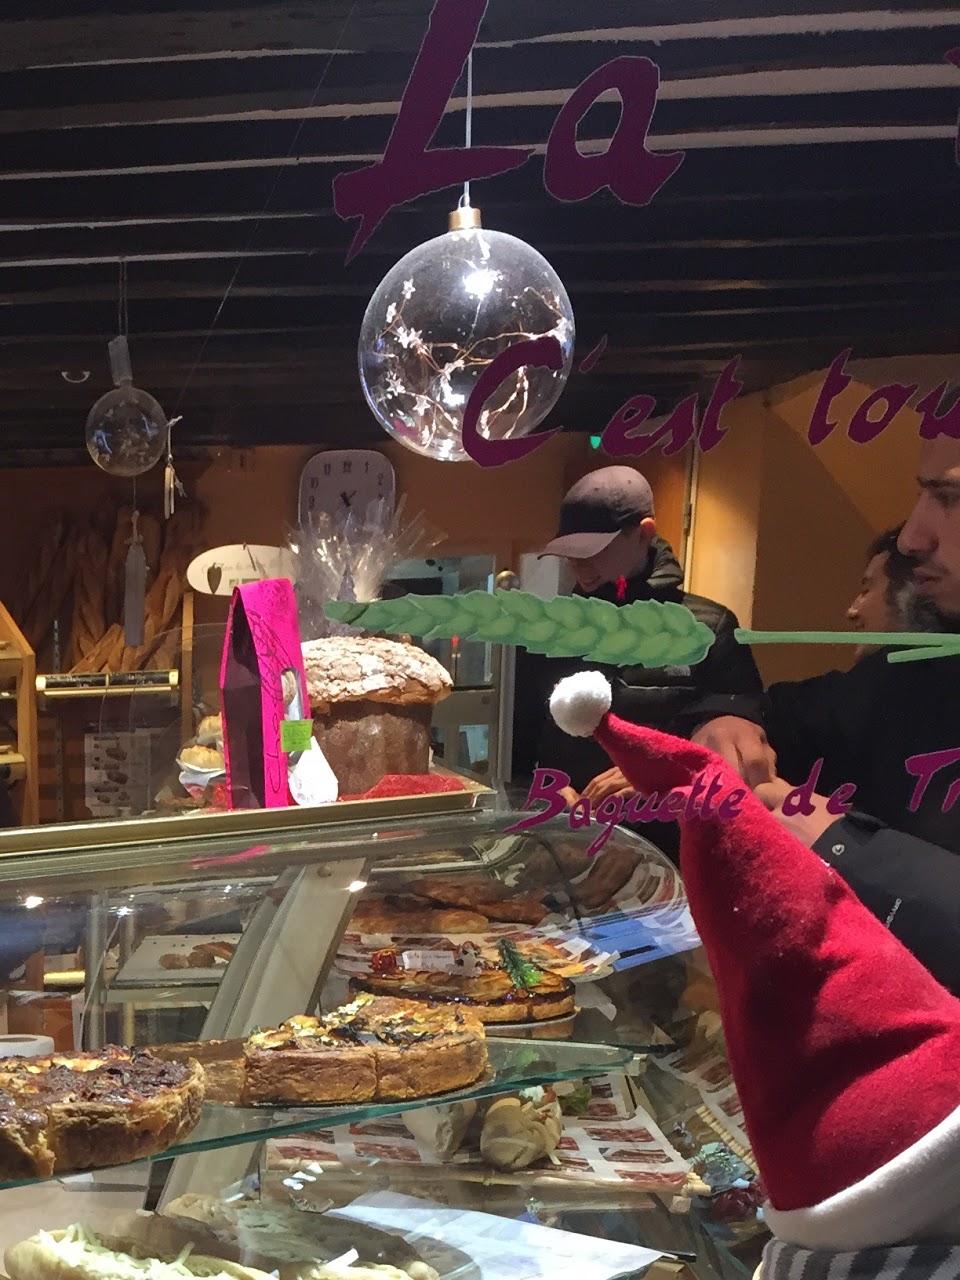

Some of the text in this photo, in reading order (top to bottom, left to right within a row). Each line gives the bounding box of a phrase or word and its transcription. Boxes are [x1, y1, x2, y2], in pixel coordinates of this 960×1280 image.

[332, 0, 686, 265] La
[461, 334, 960, 468] C'est tou
[502, 767, 748, 857] Baguette
[781, 757, 857, 817] de
